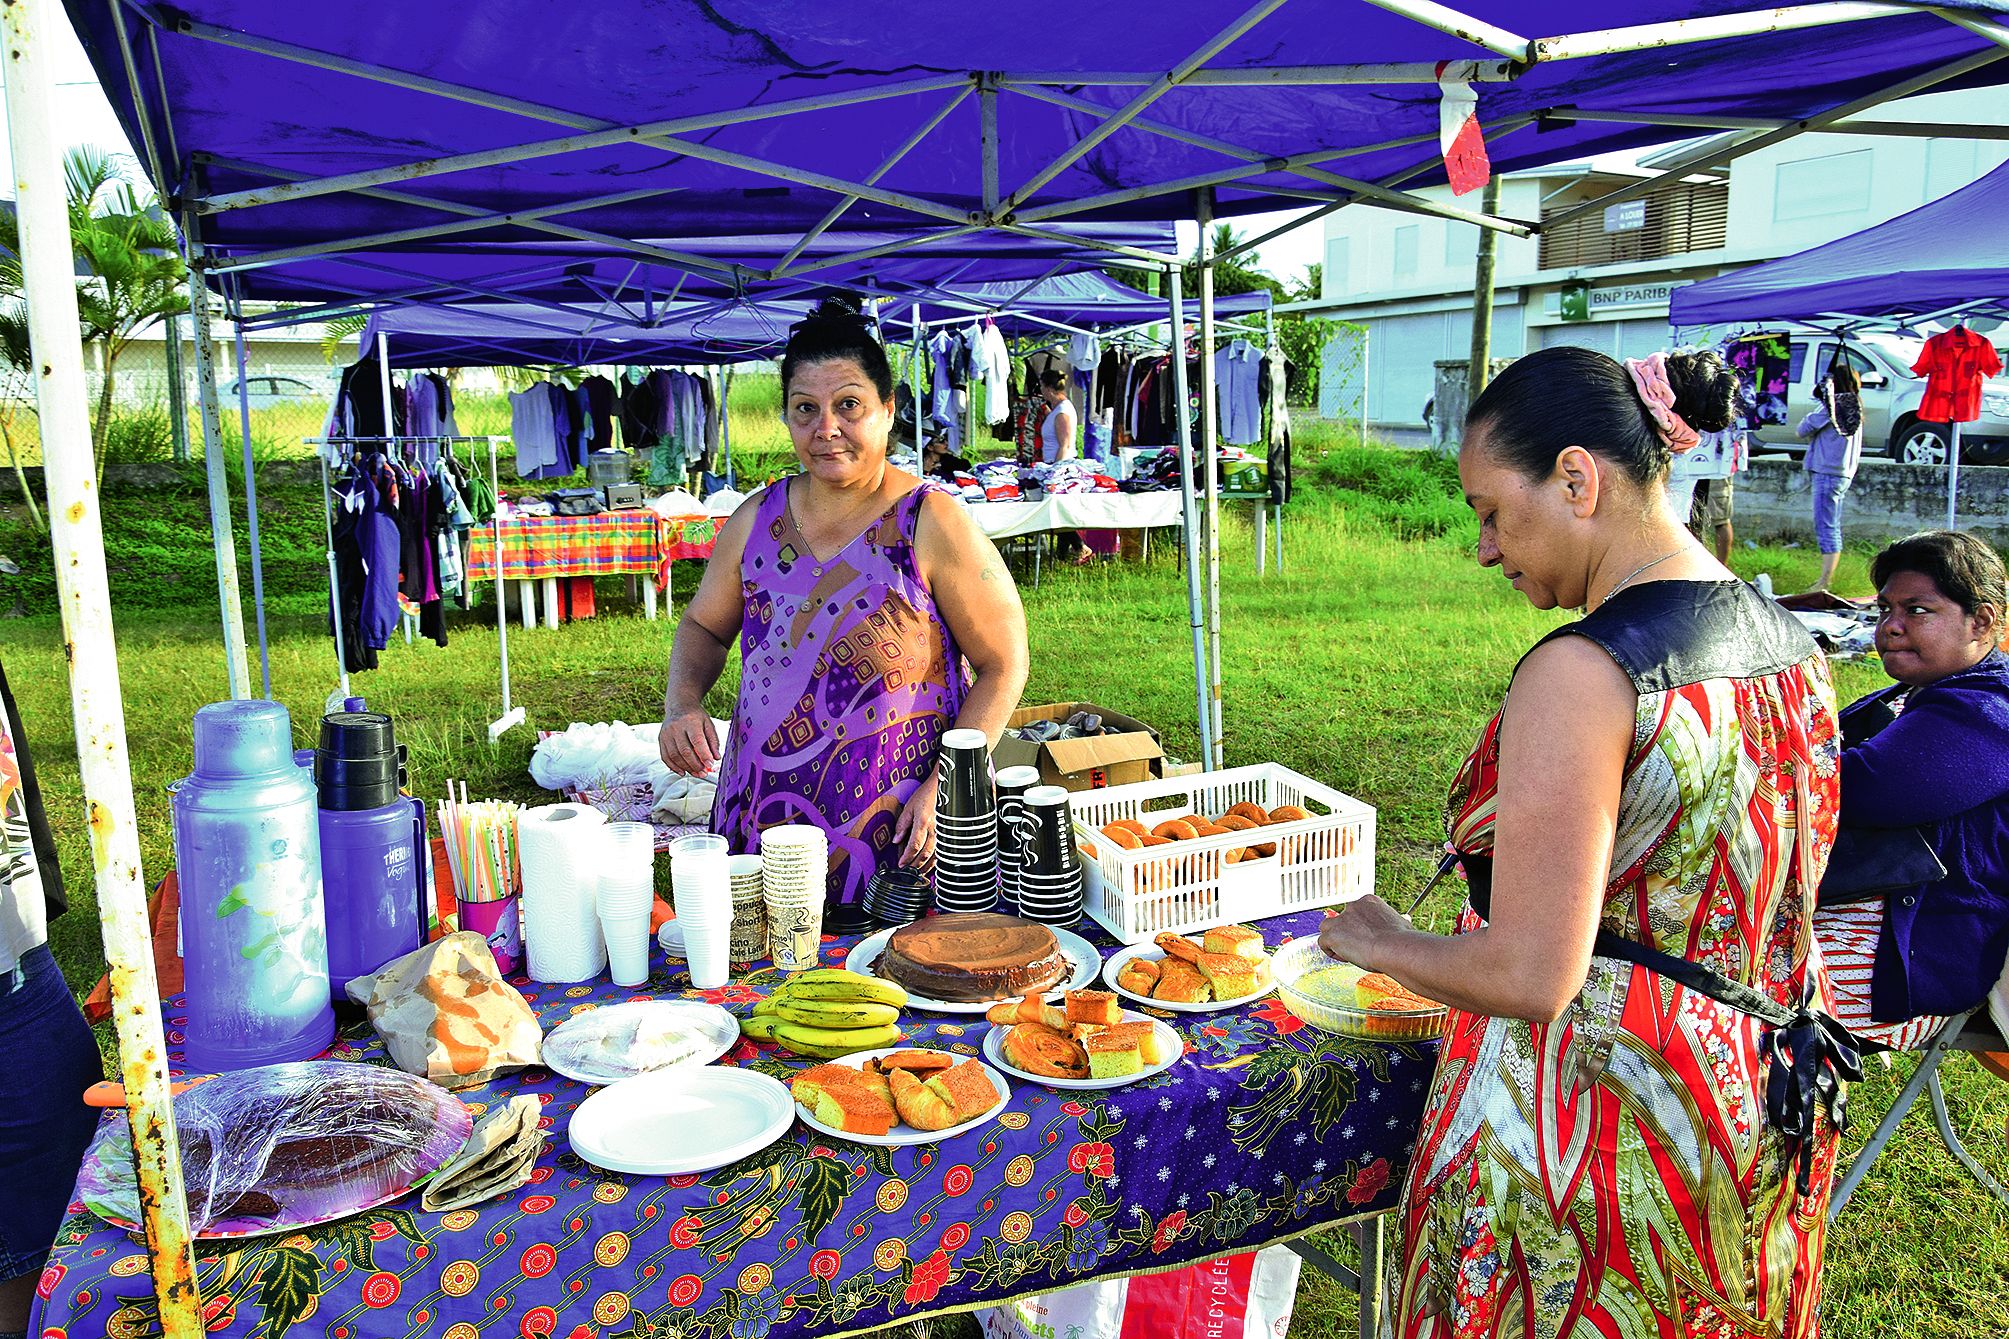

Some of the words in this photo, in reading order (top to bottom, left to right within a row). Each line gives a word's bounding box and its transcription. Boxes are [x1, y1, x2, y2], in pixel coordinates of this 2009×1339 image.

[1593, 291, 1621, 304] BNP
[387, 865, 410, 881] Vog
[736, 915, 761, 928] Short
